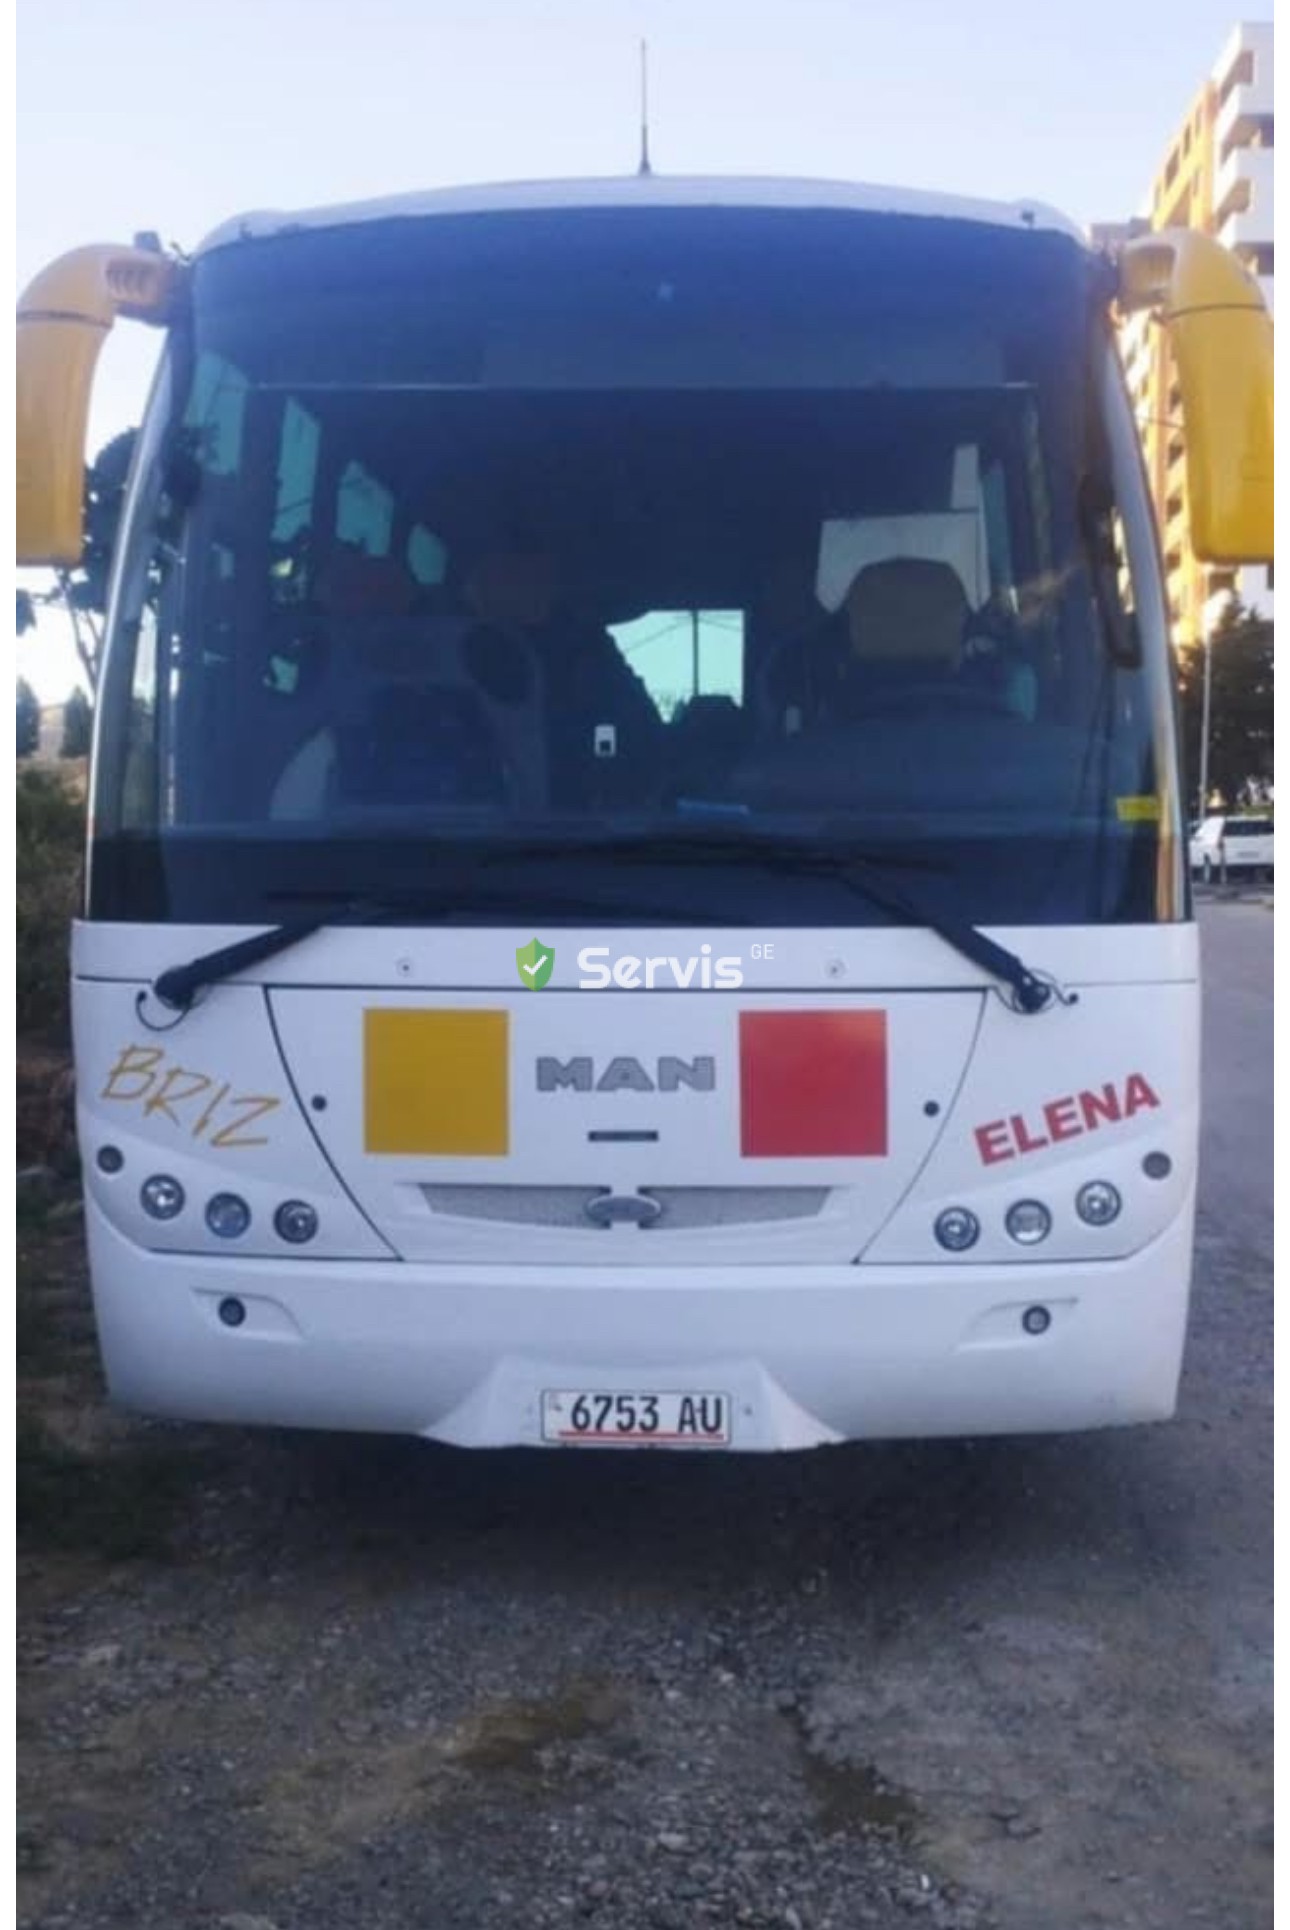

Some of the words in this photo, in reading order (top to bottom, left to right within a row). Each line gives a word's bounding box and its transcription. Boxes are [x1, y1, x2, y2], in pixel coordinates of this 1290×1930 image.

[101, 1044, 281, 1147] BRIZ
[536, 1056, 715, 1092] MAN
[974, 1072, 1160, 1165] ELENA
[571, 1395, 659, 1432] 6753
[678, 1396, 722, 1433] AU
